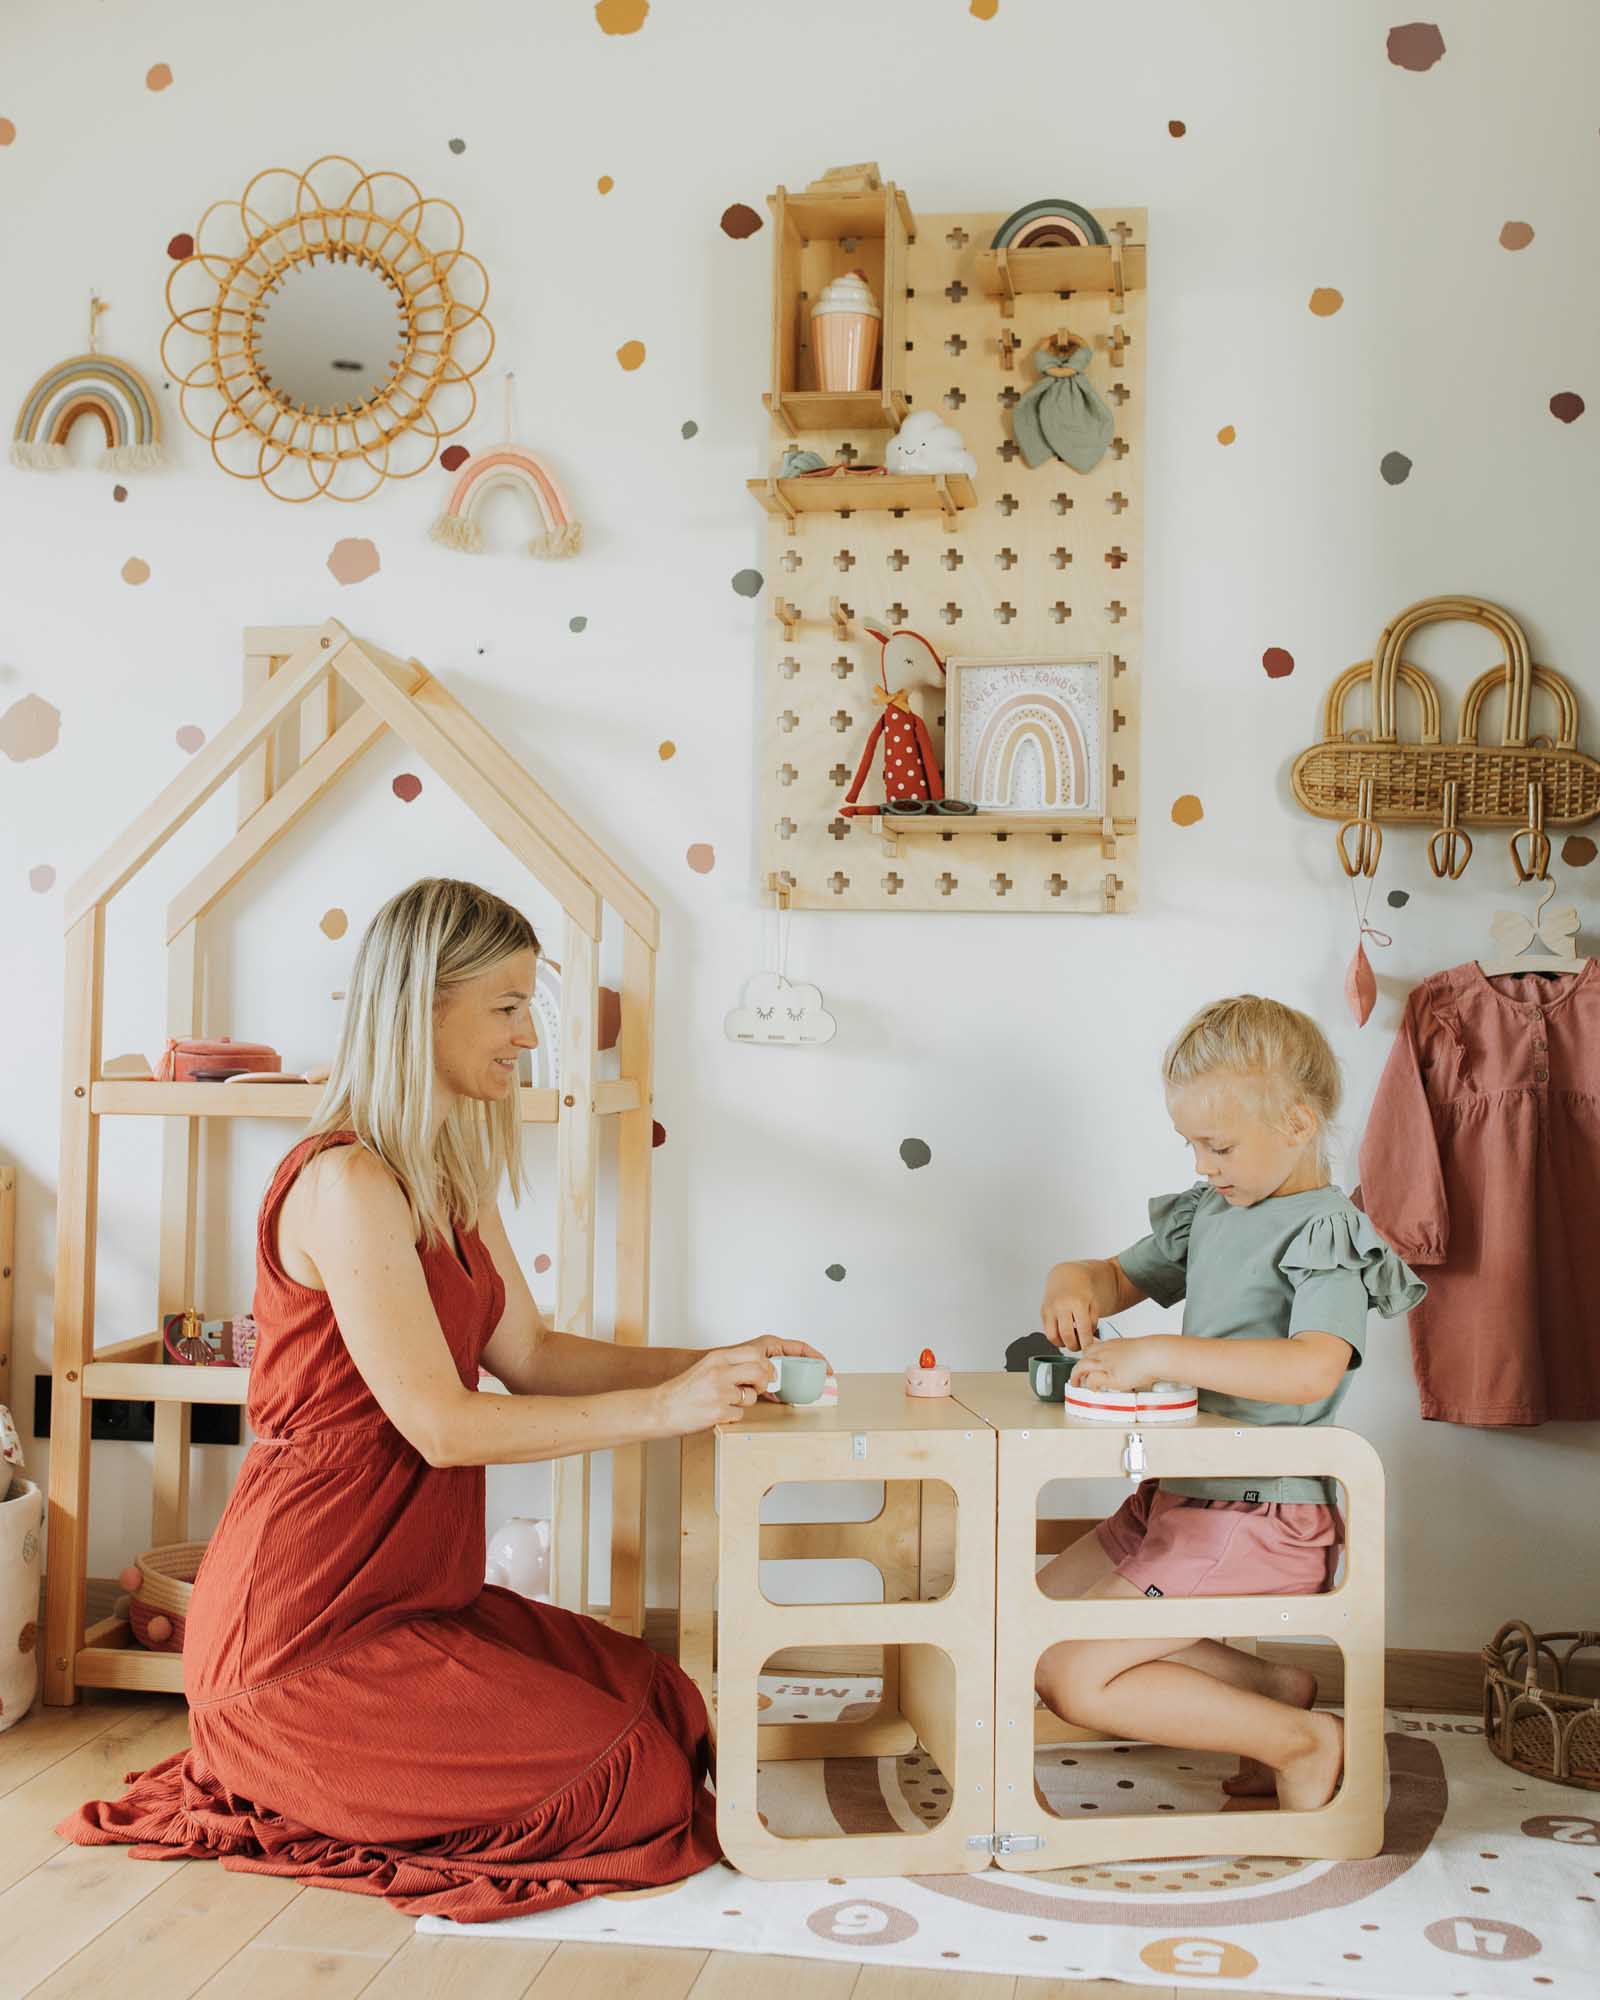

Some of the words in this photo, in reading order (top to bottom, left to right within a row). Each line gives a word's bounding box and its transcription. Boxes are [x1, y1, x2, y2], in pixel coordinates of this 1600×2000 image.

[1549, 1820, 1598, 1843] 2
[1454, 1920, 1508, 1955] 4
[1171, 1942, 1224, 1973] 5
